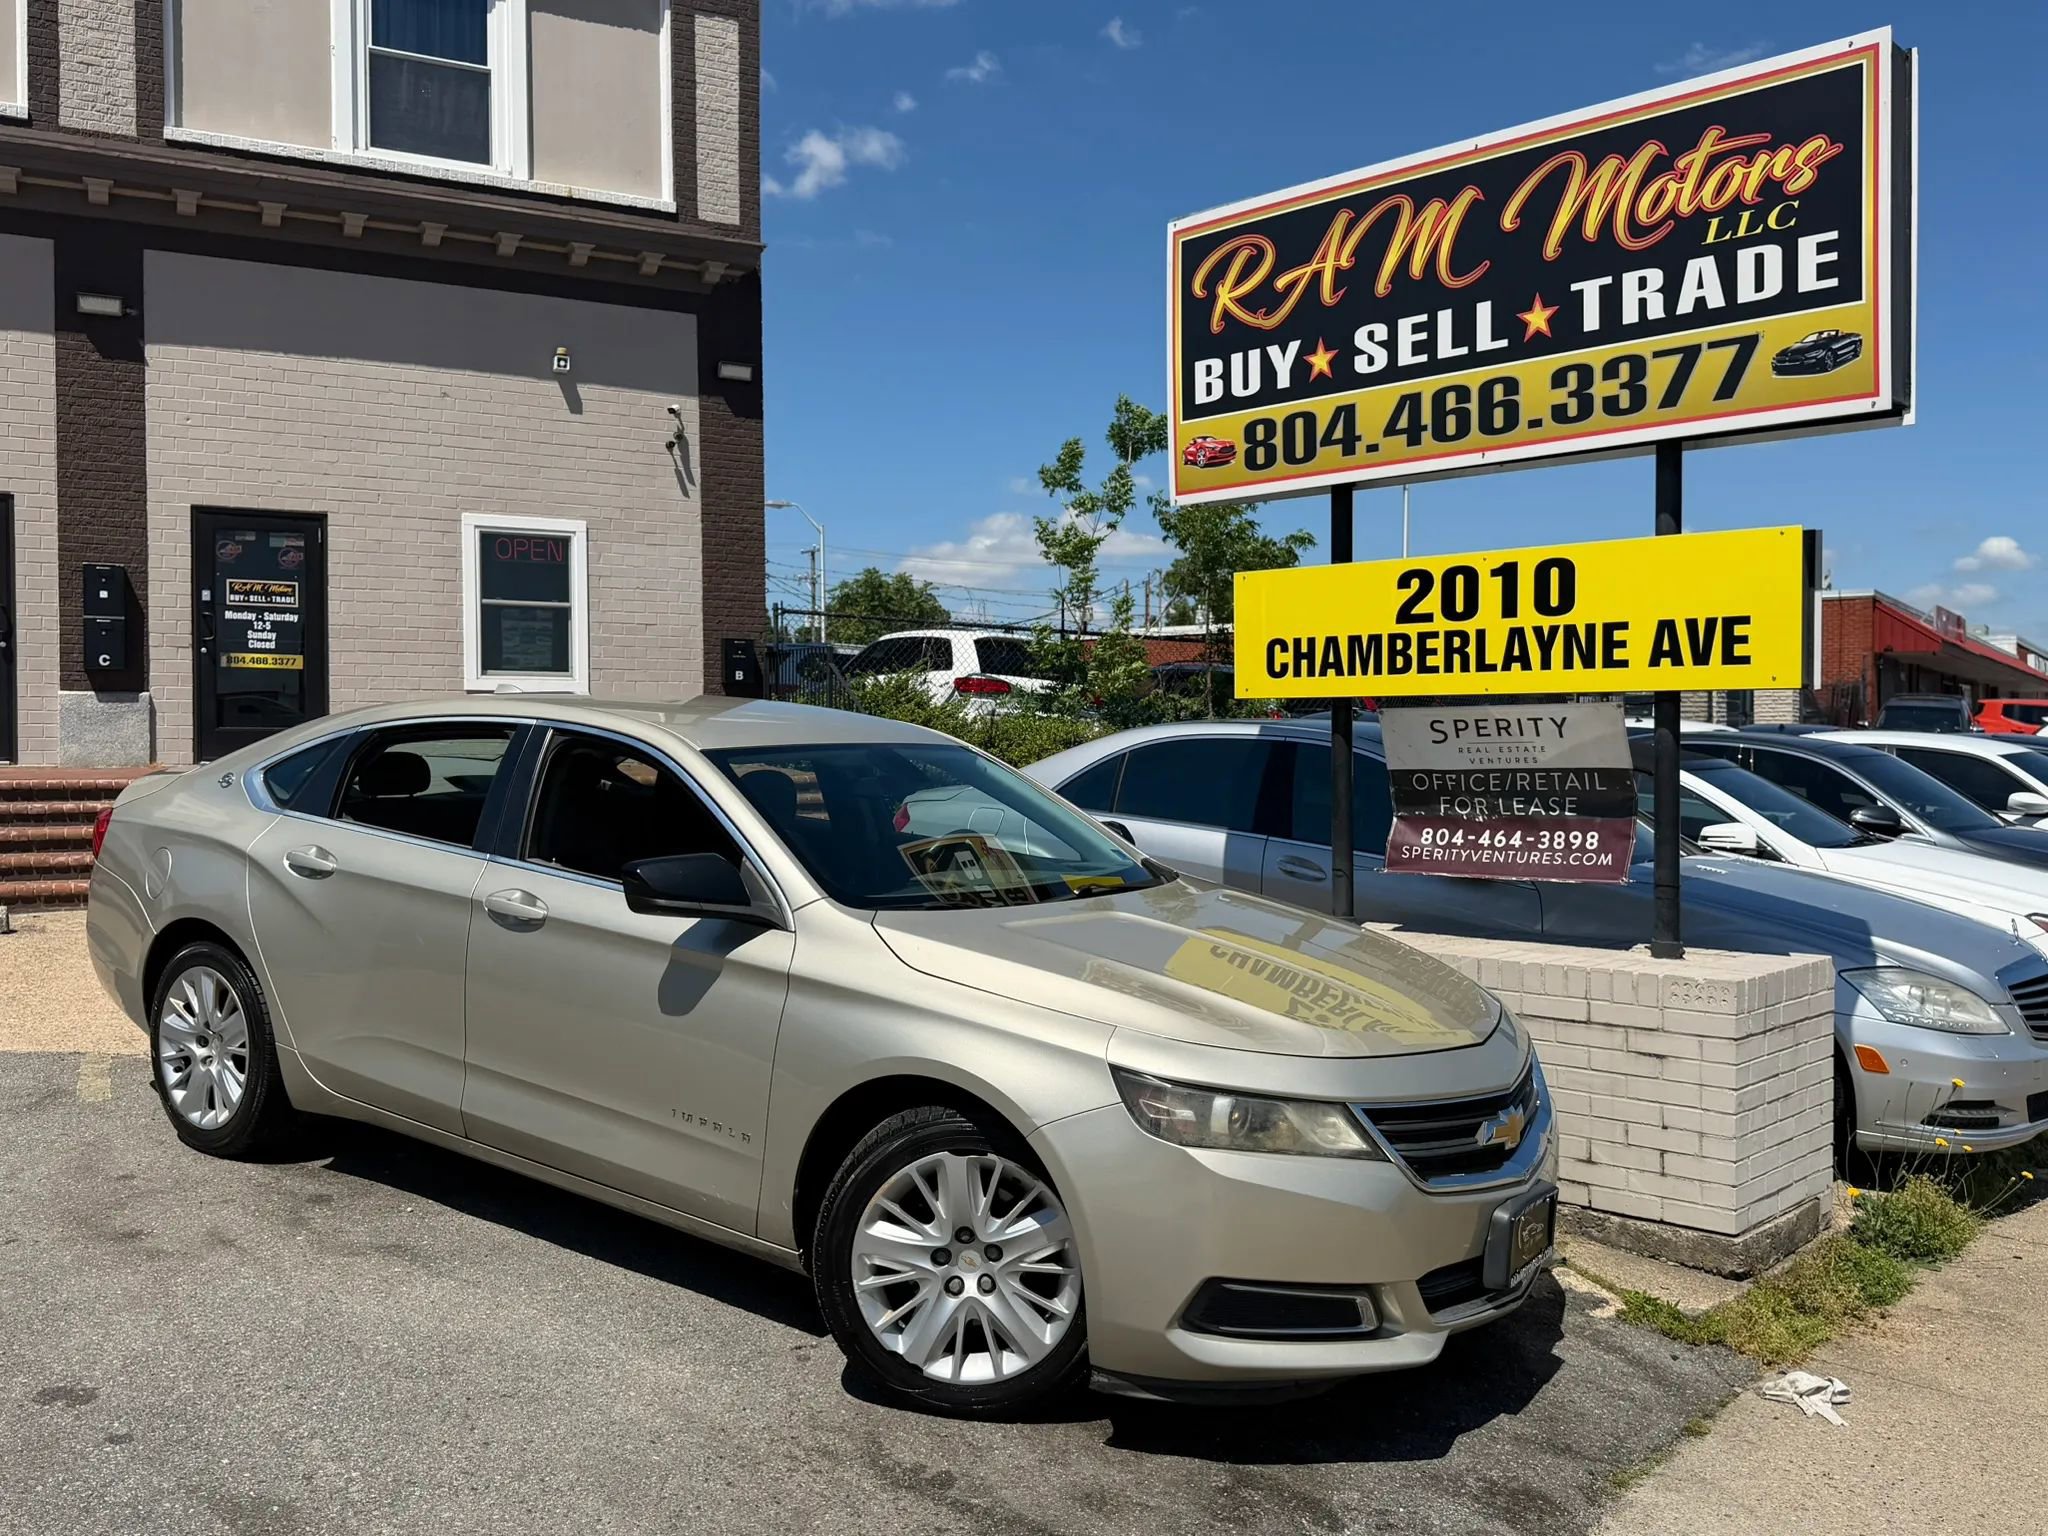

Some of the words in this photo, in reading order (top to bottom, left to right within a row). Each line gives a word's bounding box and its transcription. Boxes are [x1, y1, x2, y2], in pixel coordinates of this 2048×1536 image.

[1192, 184, 1490, 334] RAM
[1500, 124, 1844, 261] Motors
[1701, 200, 1799, 245] LLC
[1194, 340, 1301, 405] BUY
[1353, 300, 1509, 375] SELL
[1570, 230, 1840, 333] TRADE
[1243, 330, 1761, 472] 804.466.3377
[495, 537, 563, 561] OPEN
[230, 594, 245, 602] BUY
[249, 594, 266, 602] SELL
[271, 595, 295, 604] TRADE
[1395, 557, 1576, 625] 2010
[224, 610, 257, 621] Monday
[263, 611, 299, 623] Saturday
[253, 621, 272, 630] 12-5
[247, 630, 277, 641] Sunday
[248, 640, 276, 649] Closed
[1266, 621, 1630, 679] CHAMBERLAYNE
[1648, 615, 1752, 667] AVE
[98, 654, 111, 666] C
[735, 670, 744, 680] B
[1429, 716, 1568, 744] SPERITY
[1499, 745, 1546, 753] ESTATE
[1469, 757, 1539, 765] VENTURES
[1412, 772, 1608, 792] OFFICE/RETAIL
[1440, 796, 1488, 816] FOR
[1498, 797, 1578, 816] LEASE
[1420, 827, 1600, 850] 804-464-3898
[1401, 845, 1613, 866] SPERITYVENTURES.COM
